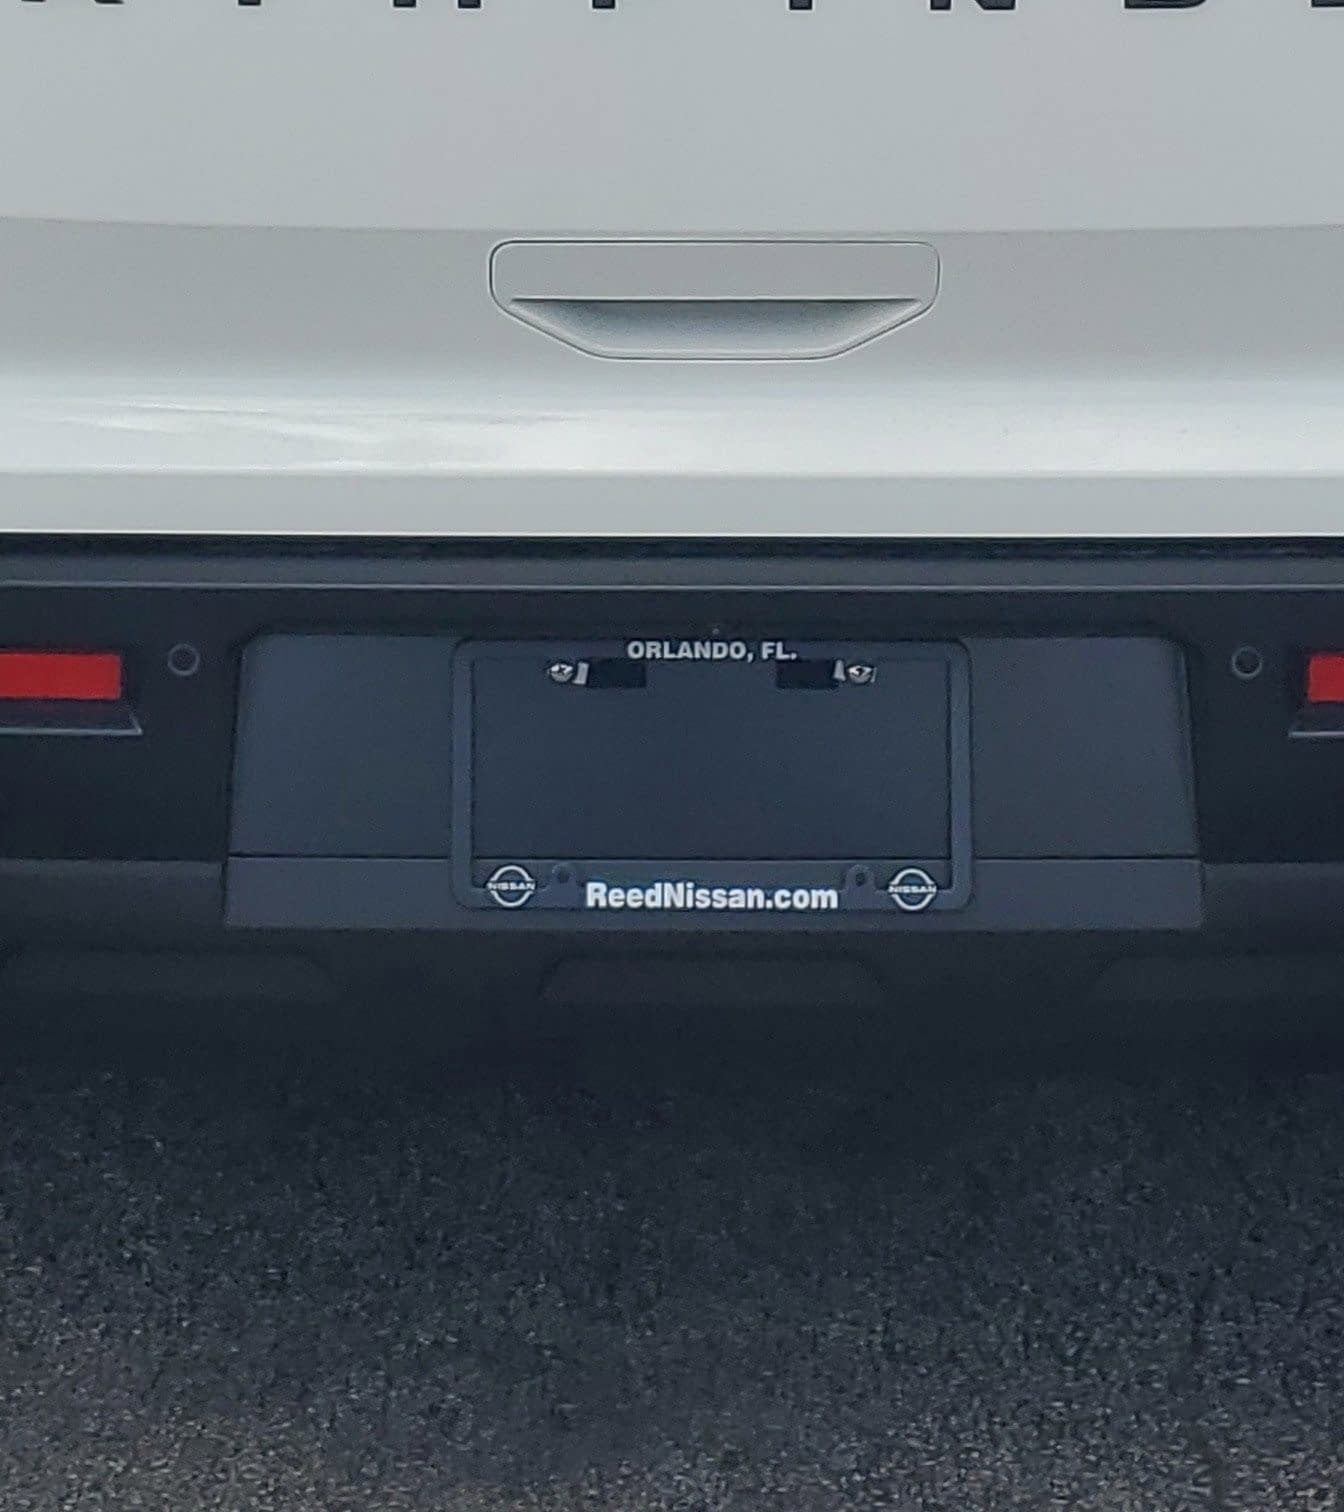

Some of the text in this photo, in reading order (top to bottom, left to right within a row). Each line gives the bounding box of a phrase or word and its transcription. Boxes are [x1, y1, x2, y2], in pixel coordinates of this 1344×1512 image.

[627, 641, 797, 662] ORLANDO, FL.
[487, 881, 535, 891] NISSAN
[889, 885, 937, 895] NISSAN
[585, 882, 839, 910] ReedNissan.com
